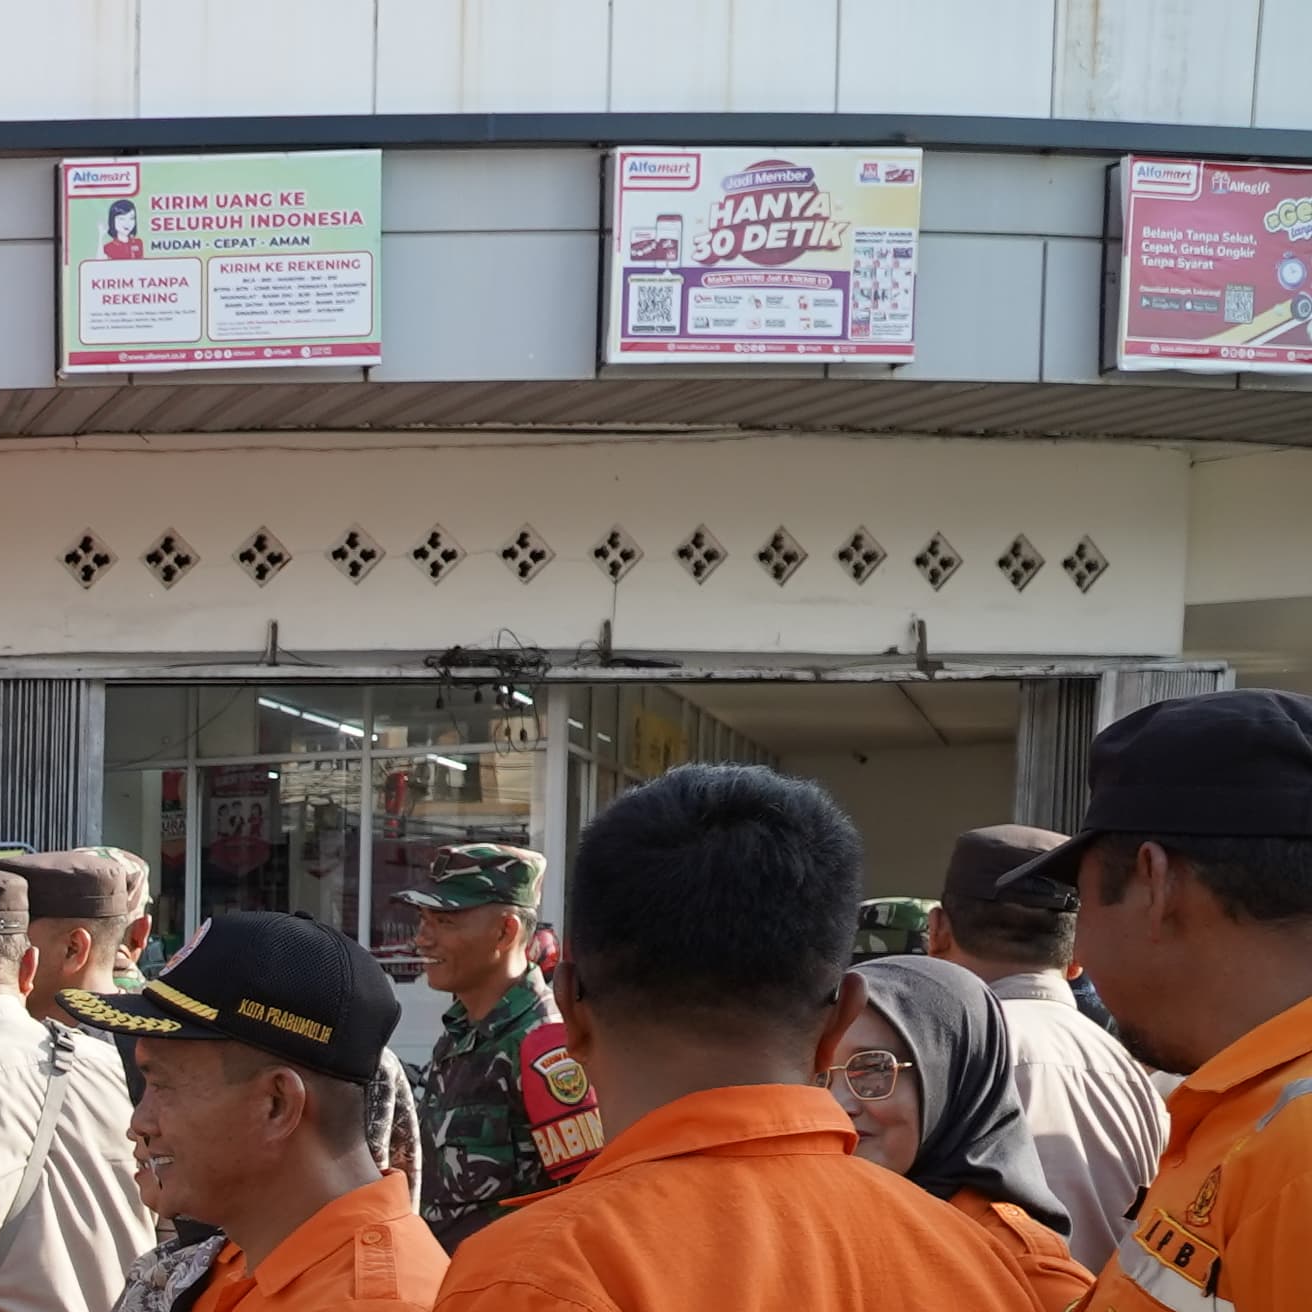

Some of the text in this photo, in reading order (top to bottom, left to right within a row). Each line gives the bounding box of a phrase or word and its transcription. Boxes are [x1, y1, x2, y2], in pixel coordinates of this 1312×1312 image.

[628, 160, 691, 175] Alfamart
[1137, 165, 1192, 181] Alfamart
[72, 170, 131, 183] Alfamart
[754, 168, 808, 187] Member
[1229, 180, 1270, 195] Alfagift
[150, 192, 305, 211] KIRIM UANG KE
[708, 190, 832, 231] HANYA
[150, 211, 364, 232] SELURUH INDONESIA
[691, 231, 736, 264] 30
[741, 220, 852, 253] DETIK
[1142, 227, 1183, 243] Belanja
[1186, 229, 1220, 243] Tanpa
[150, 236, 310, 251] MUDAH CEPAT AMAN
[1180, 243, 1214, 257] Gratis
[1217, 245, 1256, 260] Ongkir
[219, 258, 361, 274] KIRIM KE REKENING
[1141, 255, 1214, 271] Tanpa Syarat
[91, 276, 189, 290] KIRIM TANPA
[102, 292, 178, 305] REKENING
[238, 998, 333, 1044] KOTA PRABUMULIH
[531, 1107, 604, 1168] BABIN
